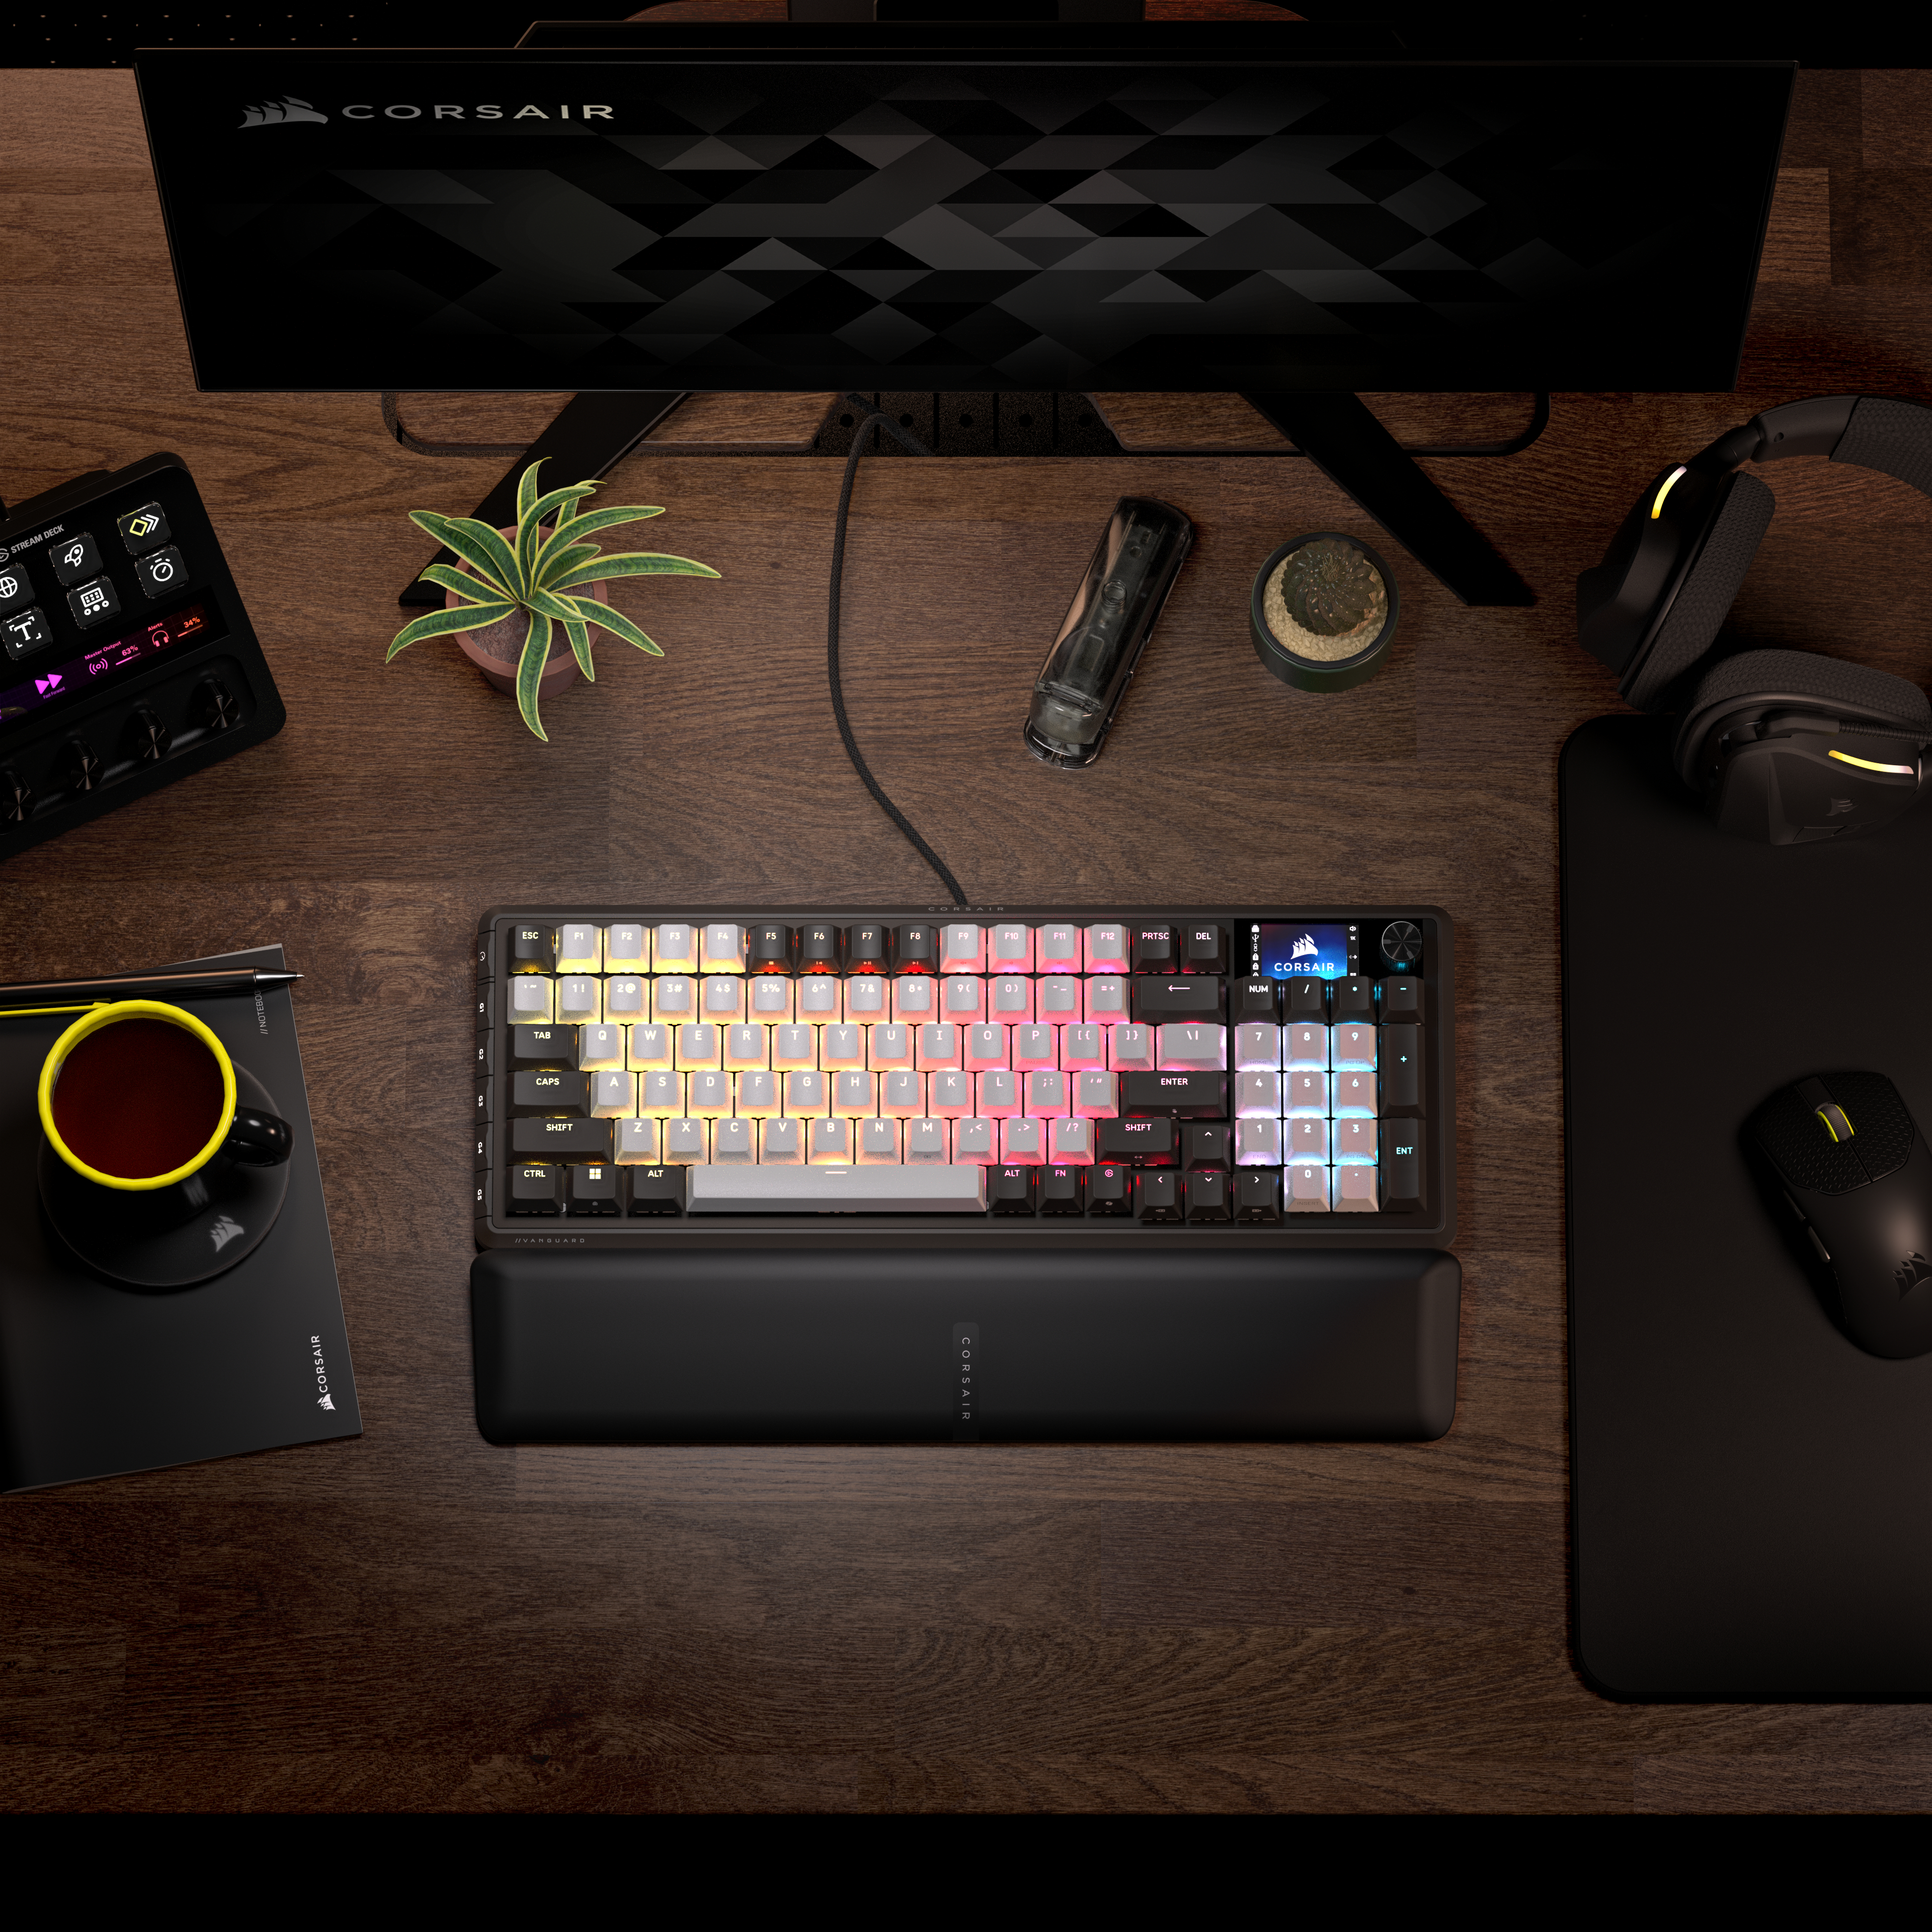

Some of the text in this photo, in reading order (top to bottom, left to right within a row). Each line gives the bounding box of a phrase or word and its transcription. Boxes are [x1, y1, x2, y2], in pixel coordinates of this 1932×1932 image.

[342, 105, 615, 119] CORSAIR
[11, 524, 65, 553] STREAM DECK
[147, 621, 163, 632] Alerts
[184, 617, 200, 628] 34%
[85, 641, 121, 660] Master Output
[122, 645, 138, 657] 63%
[51, 687, 65, 696] Forward
[522, 931, 538, 939] ESC
[574, 932, 584, 940] F1
[621, 932, 632, 940] F2
[670, 932, 680, 940] F3
[717, 932, 729, 940] F4
[1274, 962, 1335, 972] CORSAIR
[479, 1003, 484, 1012] G1
[598, 1030, 607, 1040] Q
[644, 1030, 657, 1040] W
[695, 1030, 702, 1040] E
[743, 1030, 751, 1040] R
[791, 1030, 799, 1040] T
[839, 1030, 847, 1040] Y
[887, 1030, 896, 1040] U
[936, 1030, 942, 1040] I
[984, 1030, 992, 1040] O
[1032, 1030, 1039, 1040] P
[1255, 1032, 1262, 1041] 7
[1304, 1032, 1311, 1041] 8
[1351, 1032, 1358, 1041] 9
[479, 1049, 484, 1060] G2
[609, 1076, 619, 1087] A
[658, 1076, 666, 1087] S
[706, 1076, 714, 1087] D
[755, 1076, 762, 1087] F
[802, 1076, 812, 1087] G
[851, 1077, 859, 1087] H
[900, 1077, 907, 1087] J
[947, 1077, 955, 1086] K
[997, 1077, 1003, 1087] L
[1255, 1078, 1263, 1087] 4
[1304, 1078, 1311, 1087] 5
[1352, 1078, 1359, 1087] 6
[478, 1095, 483, 1107] G3
[634, 1122, 642, 1133] Z
[682, 1122, 690, 1132] X
[730, 1122, 739, 1132] C
[778, 1122, 787, 1132] V
[827, 1122, 835, 1133] B
[875, 1122, 883, 1132] N
[922, 1122, 932, 1132] M
[1257, 1124, 1262, 1133] 1
[1304, 1124, 1311, 1133] 2
[1352, 1124, 1359, 1133] 3
[478, 1142, 482, 1154] G4
[1396, 1147, 1413, 1155] ENT
[1305, 1169, 1312, 1178] 0
[477, 1189, 482, 1200] G5
[311, 1335, 328, 1393] CORSAIR
[962, 1337, 970, 1419] CORSAIR
